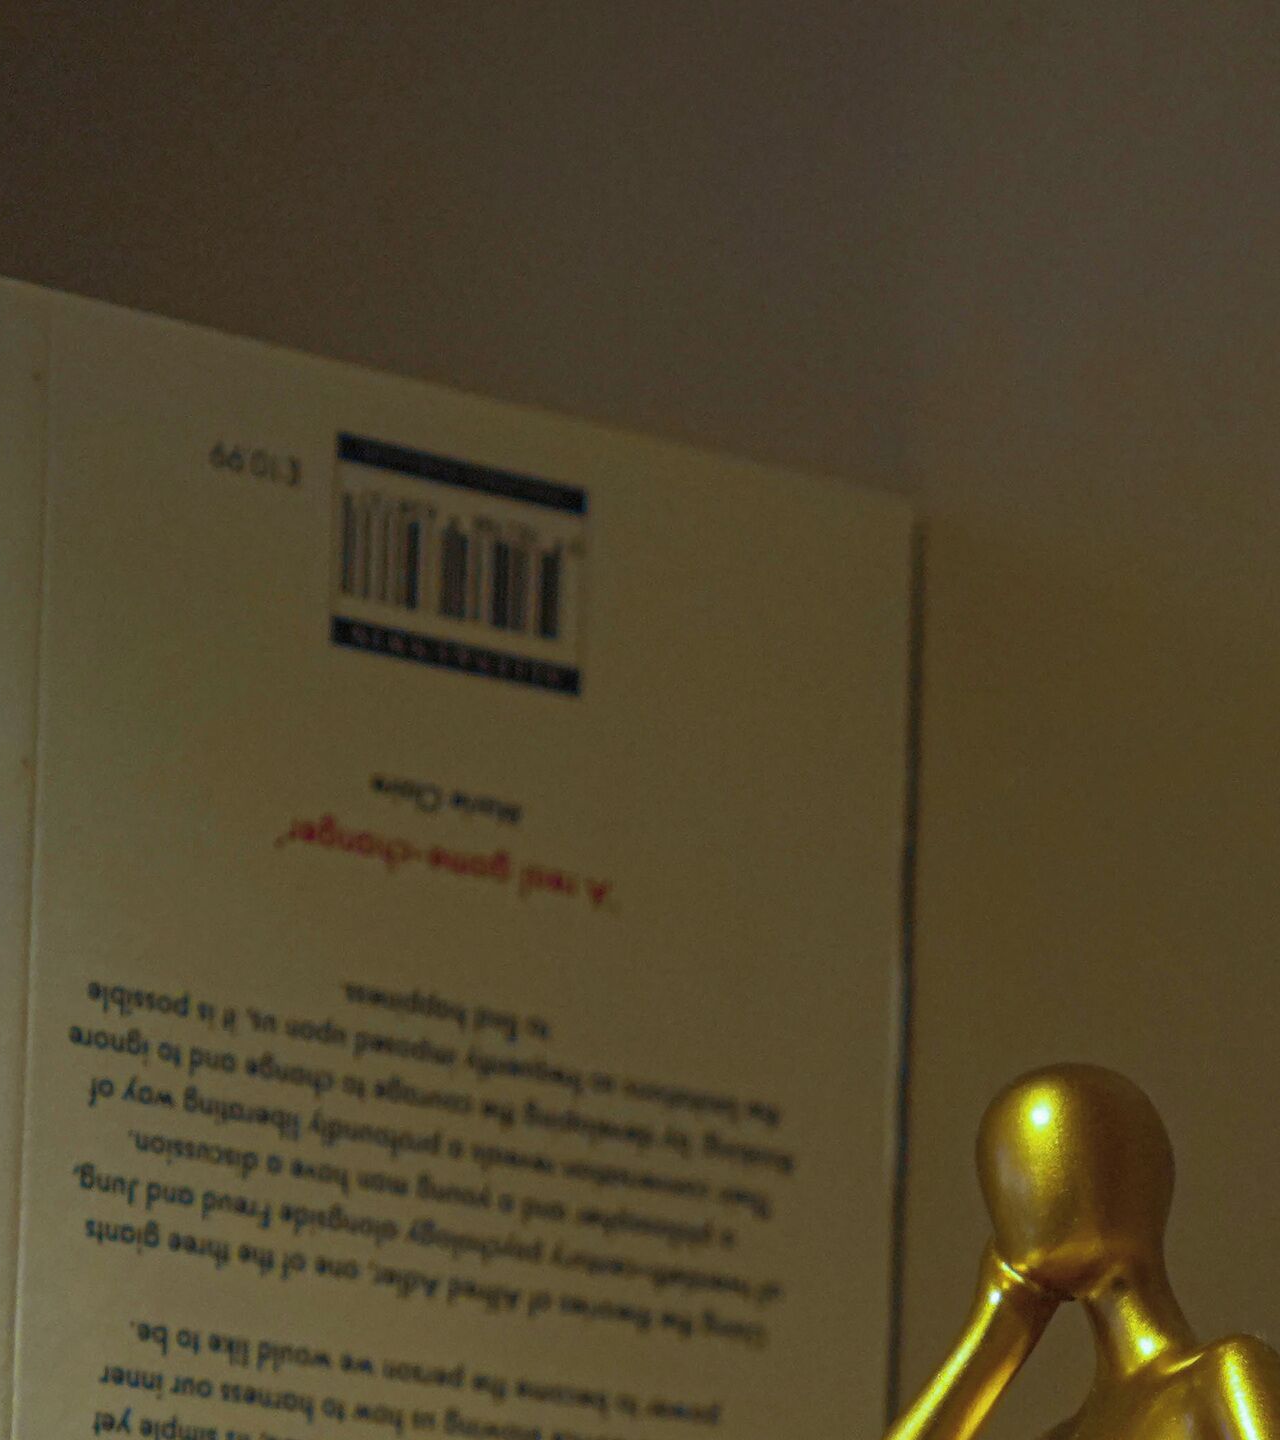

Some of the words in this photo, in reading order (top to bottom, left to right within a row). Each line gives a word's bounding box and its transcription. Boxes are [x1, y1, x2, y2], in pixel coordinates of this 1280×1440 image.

[371, 776, 444, 813] Claire
[453, 792, 523, 826] Marie
[519, 866, 579, 898] real
[86, 980, 191, 1018] possible
[195, 1000, 215, 1030] is
[220, 1006, 237, 1029] it
[66, 1024, 150, 1056] ignore
[283, 1017, 347, 1045] upon
[155, 1041, 182, 1067] to
[187, 1046, 237, 1076] and
[243, 1050, 336, 1100] change
[340, 1073, 366, 1099] to
[87, 1076, 115, 1107] of
[121, 1076, 174, 1108] way
[181, 1085, 301, 1140] liberating
[308, 1111, 442, 1158] profoundly
[127, 1129, 259, 1179] discussion.
[265, 1153, 283, 1175] a
[72, 1160, 139, 1205] Jung,
[289, 1158, 350, 1193] have
[355, 1171, 409, 1197] man
[144, 1180, 195, 1210] and
[200, 1190, 272, 1229] Freud
[84, 1217, 161, 1249] giants
[277, 1202, 399, 1246] alongside
[167, 1231, 230, 1268] three
[234, 1243, 275, 1273] the
[280, 1251, 307, 1281] of
[313, 1255, 360, 1280] one
[129, 1321, 168, 1355] be.
[174, 1328, 201, 1355] to
[207, 1333, 249, 1368] like
[255, 1340, 331, 1372] would
[338, 1353, 374, 1374] we
[98, 1365, 163, 1392] inner
[169, 1376, 213, 1399] our
[381, 1360, 466, 1388] person
[219, 1382, 314, 1423] harness
[319, 1397, 346, 1424] to
[92, 1407, 132, 1436] yet
[349, 1404, 404, 1434] how
